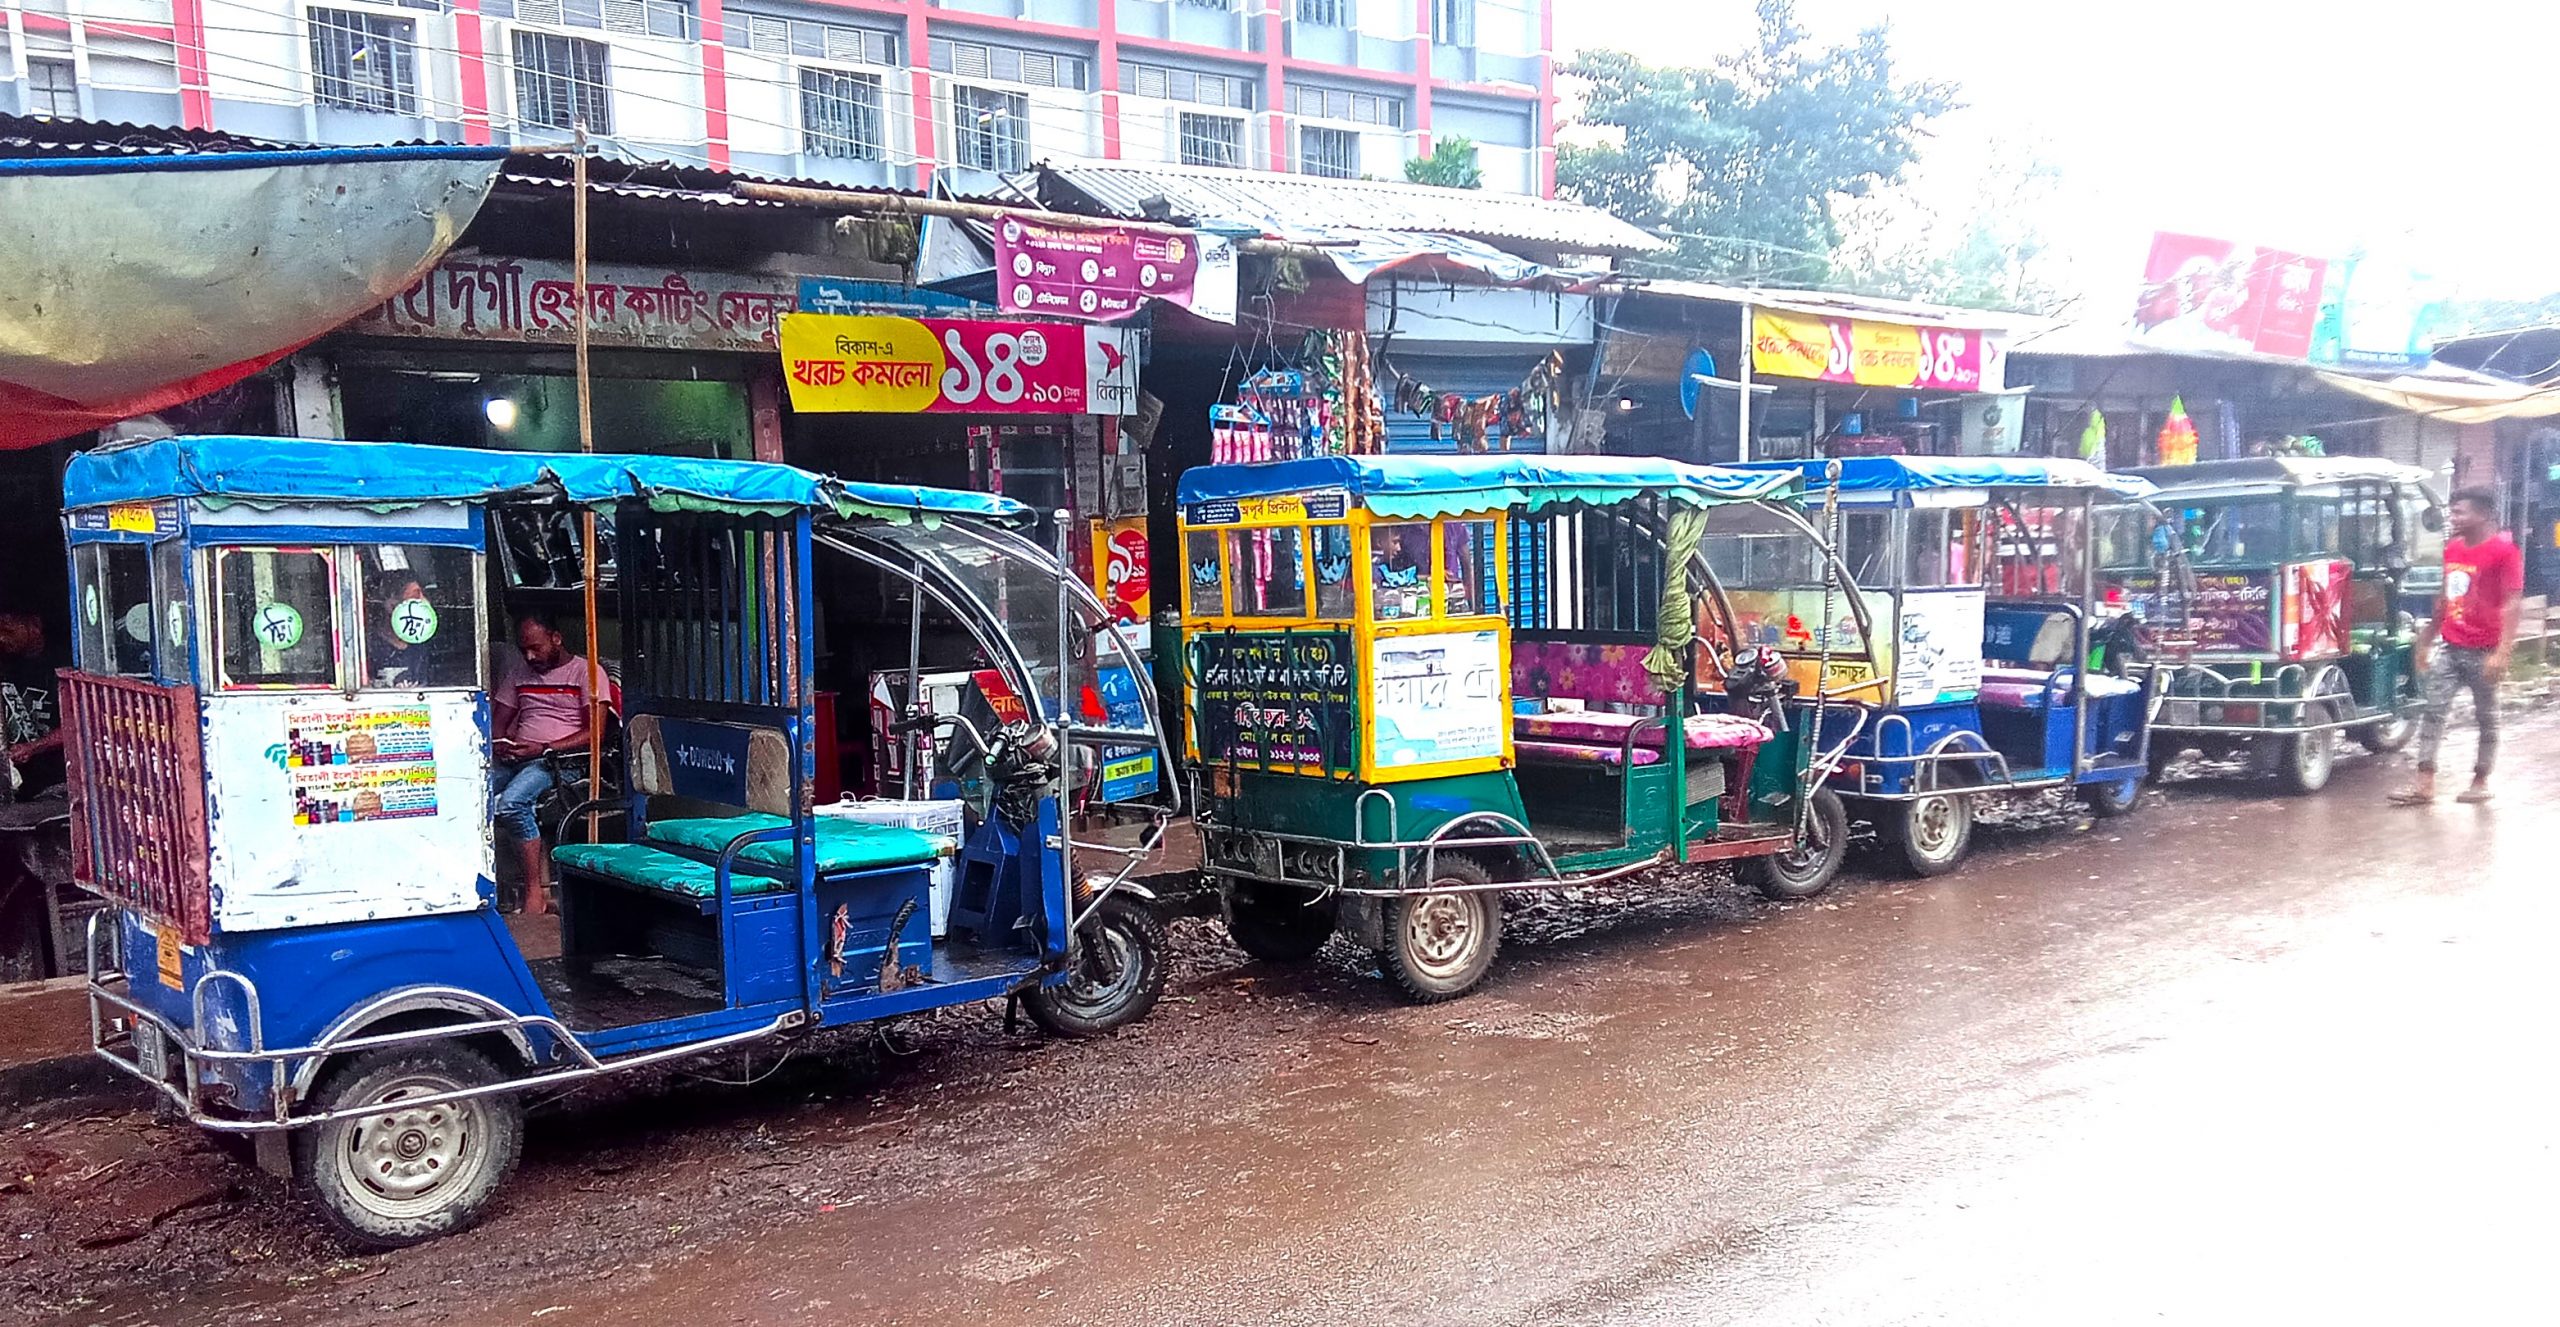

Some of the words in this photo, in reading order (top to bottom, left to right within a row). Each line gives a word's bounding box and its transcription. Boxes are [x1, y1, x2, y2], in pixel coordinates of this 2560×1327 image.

[622, 274, 720, 330] কাটিং
[836, 335, 893, 355] বিকাশ-এ
[794, 360, 845, 388] খরচ
[853, 361, 932, 389] কমলো
[1097, 381, 1132, 400] বিকাশ
[1829, 664, 1867, 682] চানাচুর
